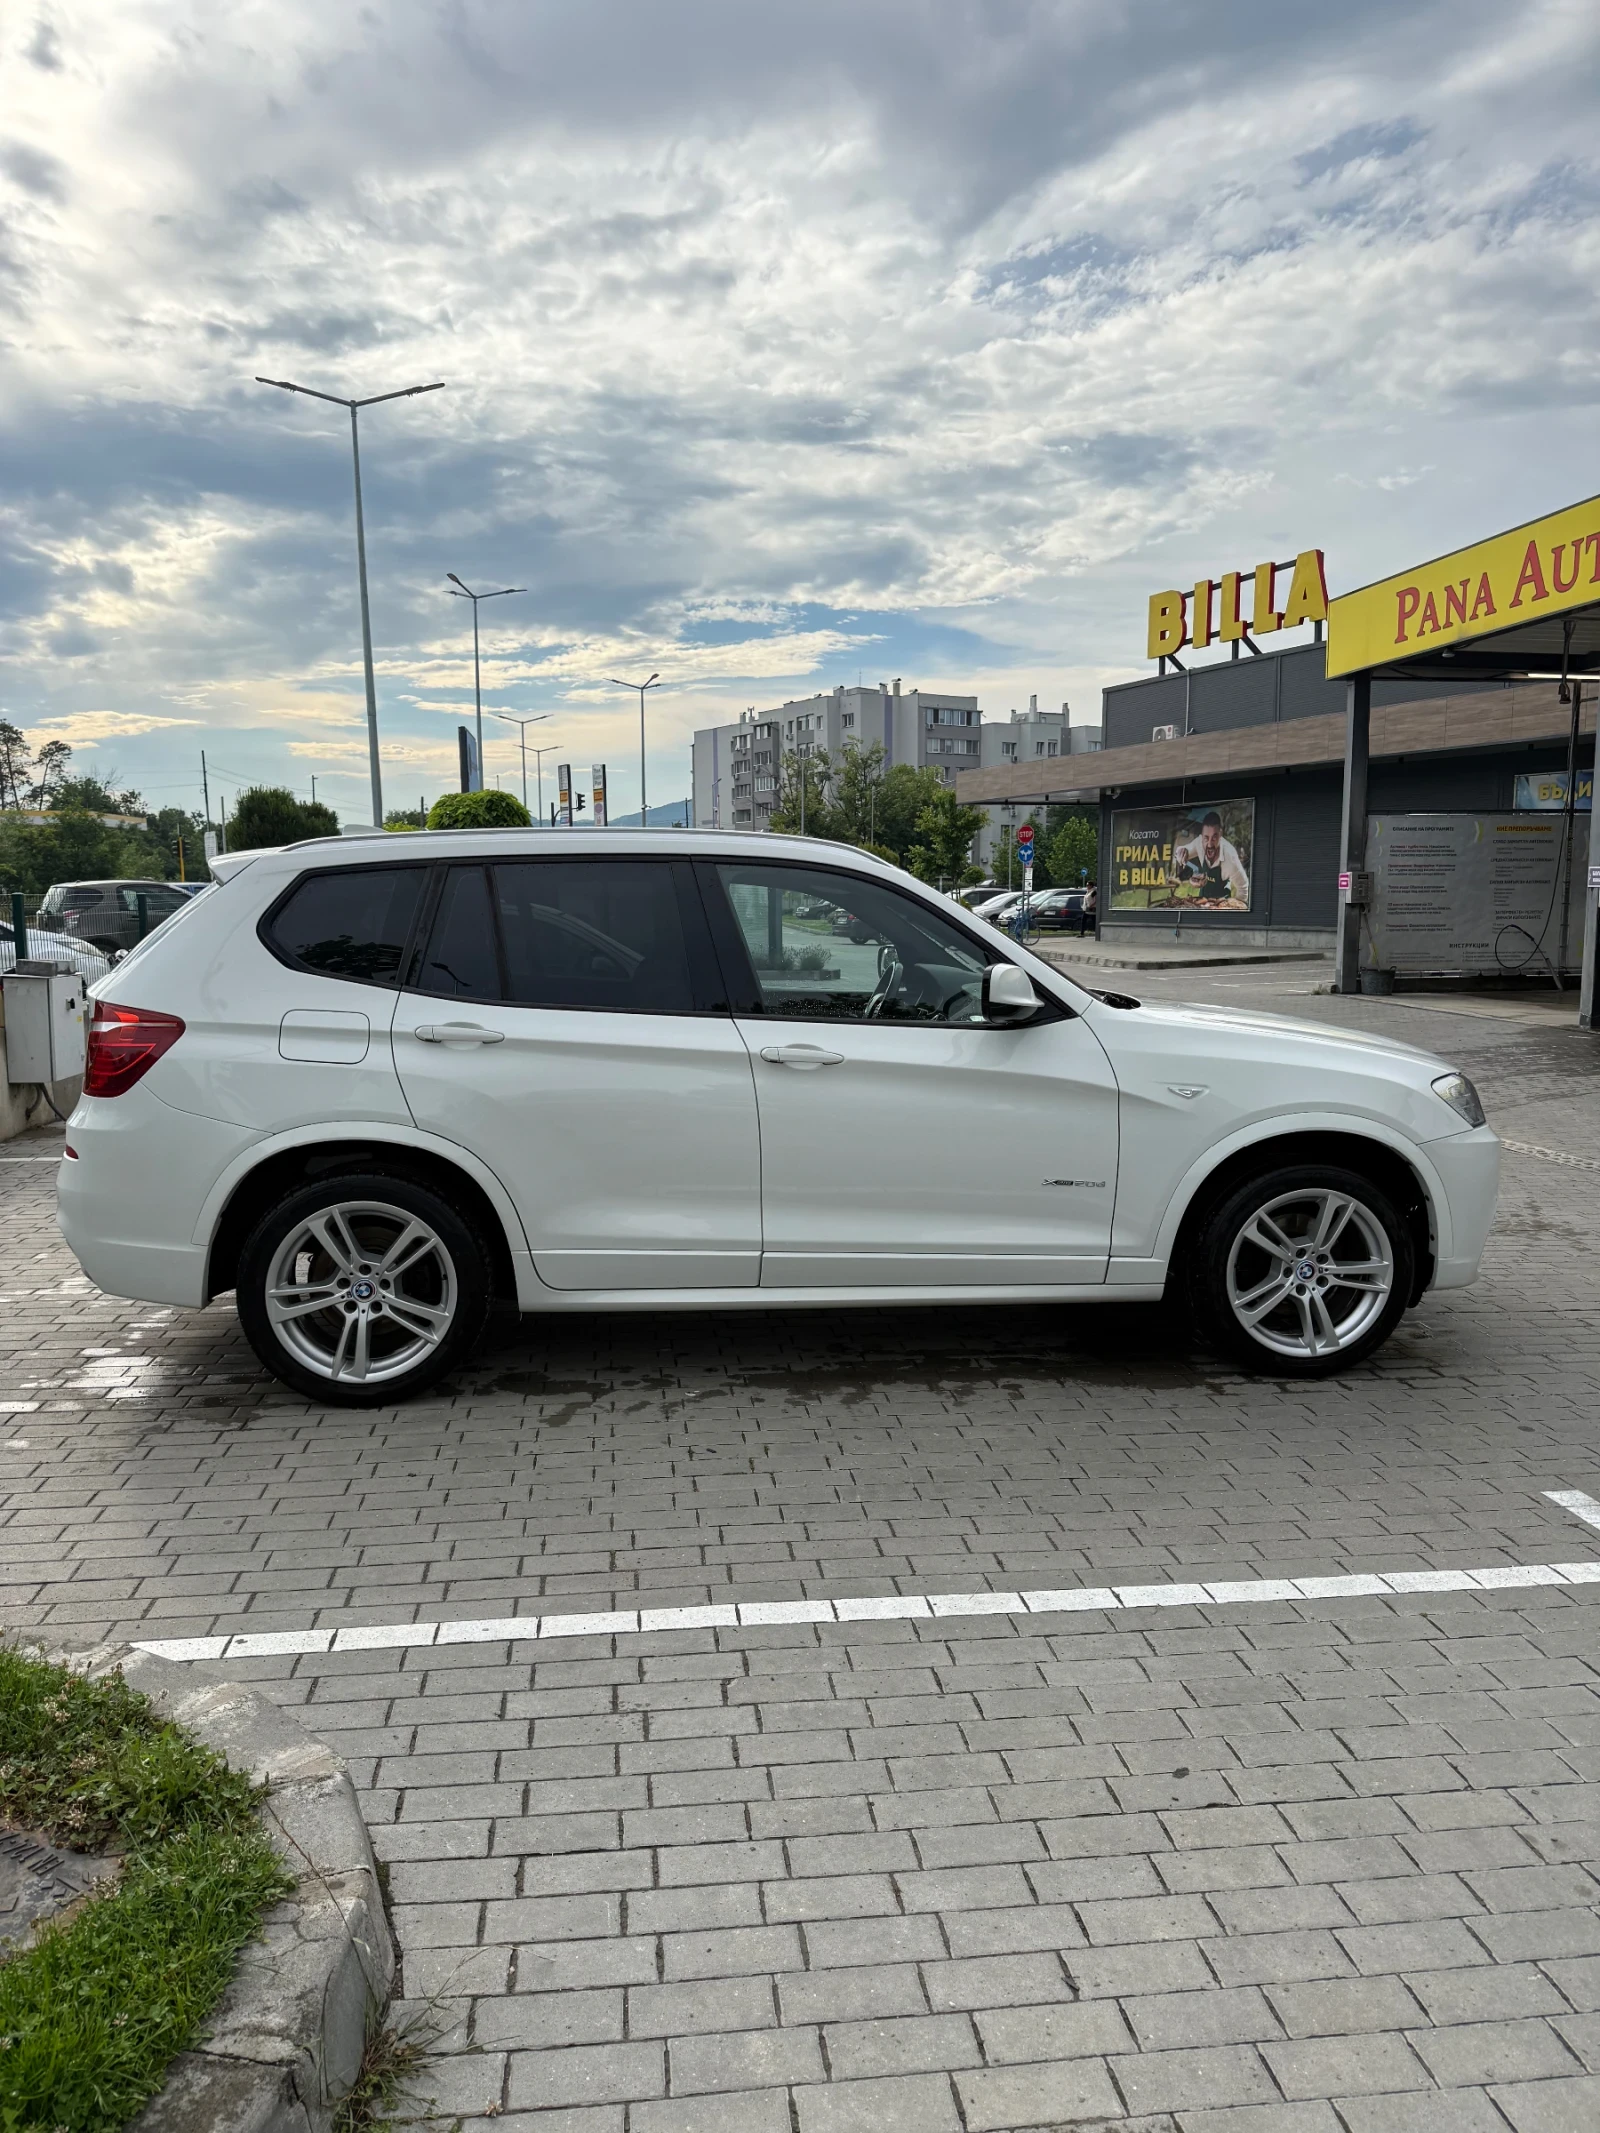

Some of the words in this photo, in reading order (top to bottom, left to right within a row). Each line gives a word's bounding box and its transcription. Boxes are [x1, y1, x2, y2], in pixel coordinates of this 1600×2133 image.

[1147, 549, 1329, 659] BILLA
[1394, 572, 1497, 644] PANA
[1020, 830, 1033, 838] STOP
[1129, 829, 1159, 840] Когато
[1116, 844, 1159, 862] ГРИЛА
[1163, 844, 1171, 861] Е
[1131, 867, 1166, 886] BILLA
